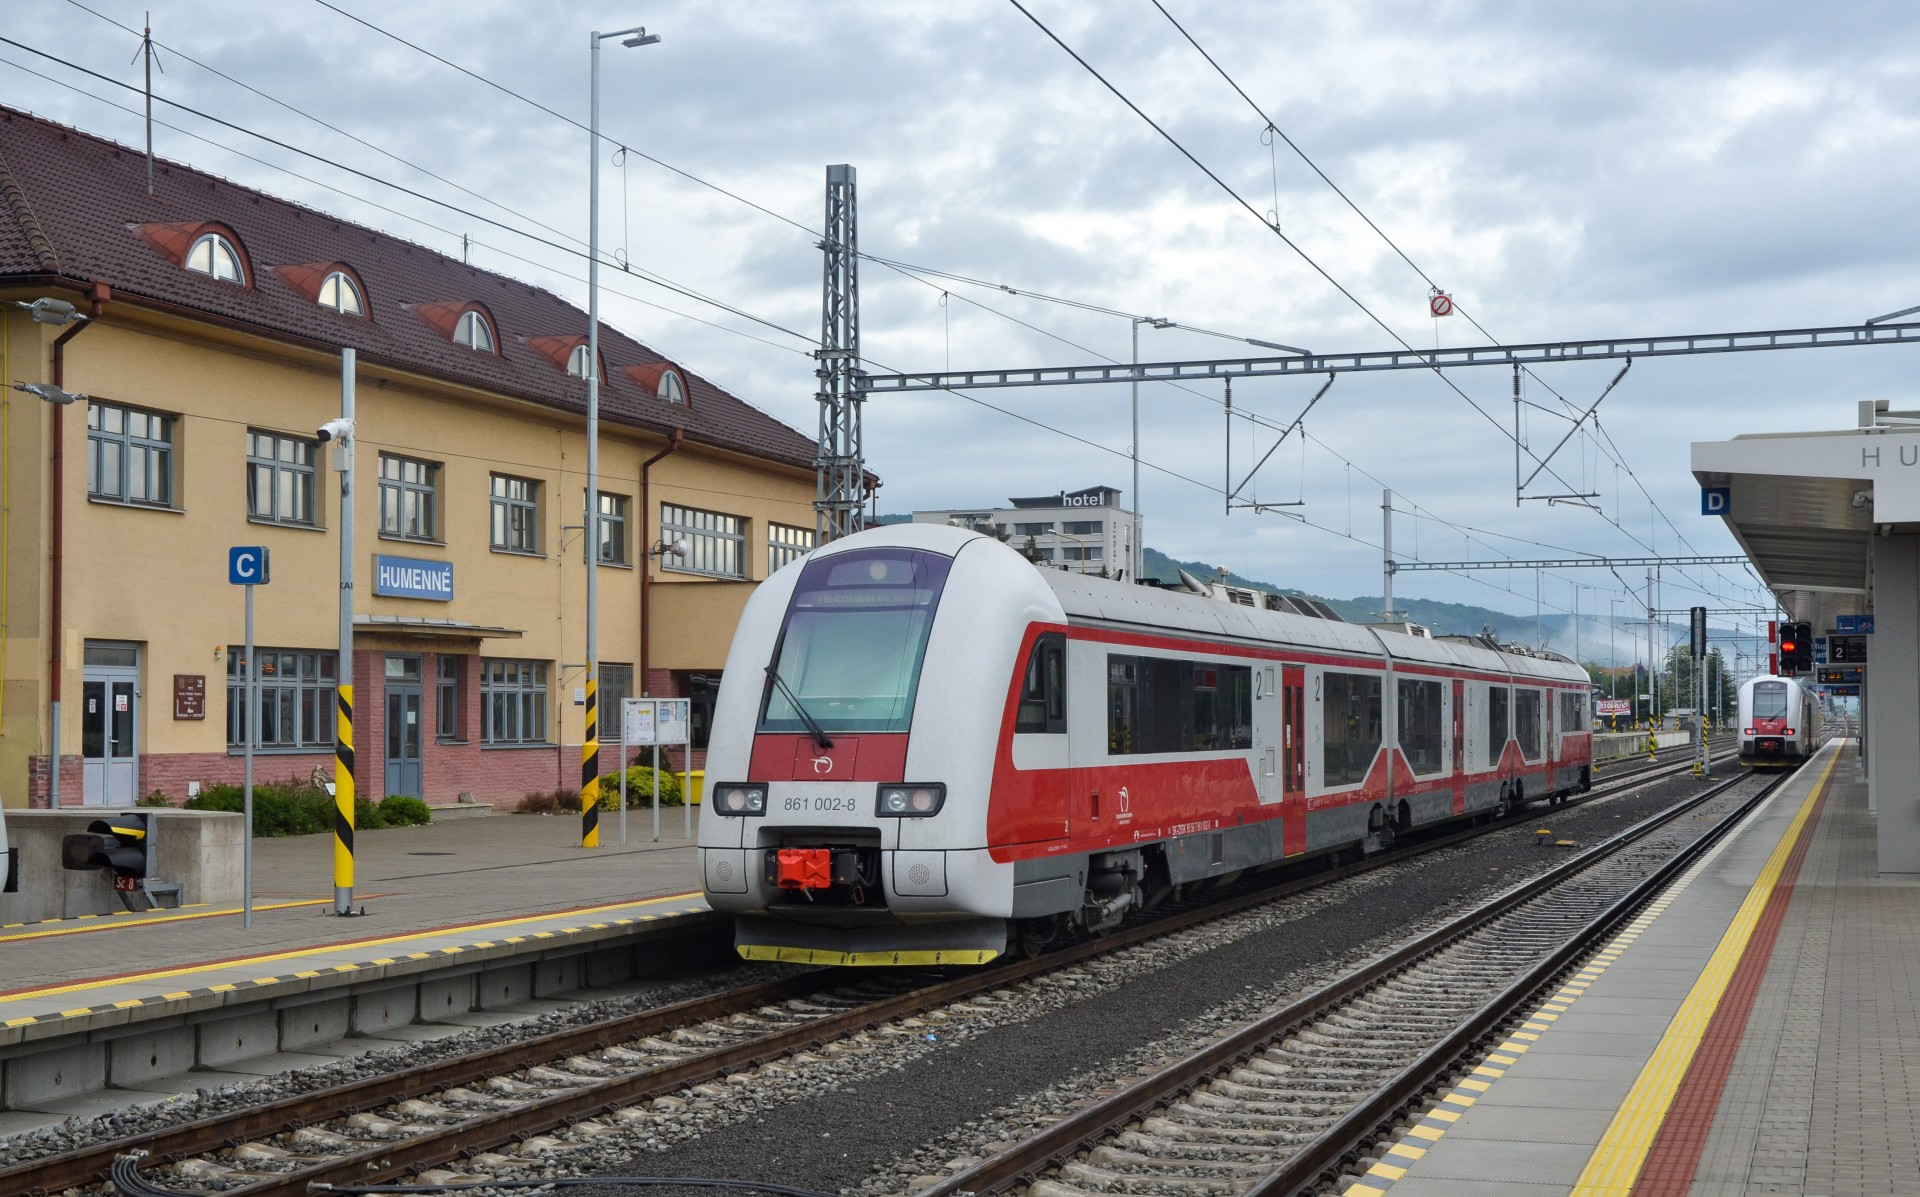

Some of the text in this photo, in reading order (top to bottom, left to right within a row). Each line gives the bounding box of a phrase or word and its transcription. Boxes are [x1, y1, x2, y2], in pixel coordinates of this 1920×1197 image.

[1063, 491, 1103, 507] hotel
[1708, 492, 1724, 510] D
[236, 553, 254, 578] C
[380, 565, 451, 592] HUMENNÉ
[1836, 647, 1843, 658] 2
[1256, 671, 1262, 700] 2
[1315, 675, 1320, 701] 2
[784, 797, 856, 812] 861 002-8
[1064, 820, 1069, 832] 2
[116, 876, 134, 890] Sc 8
